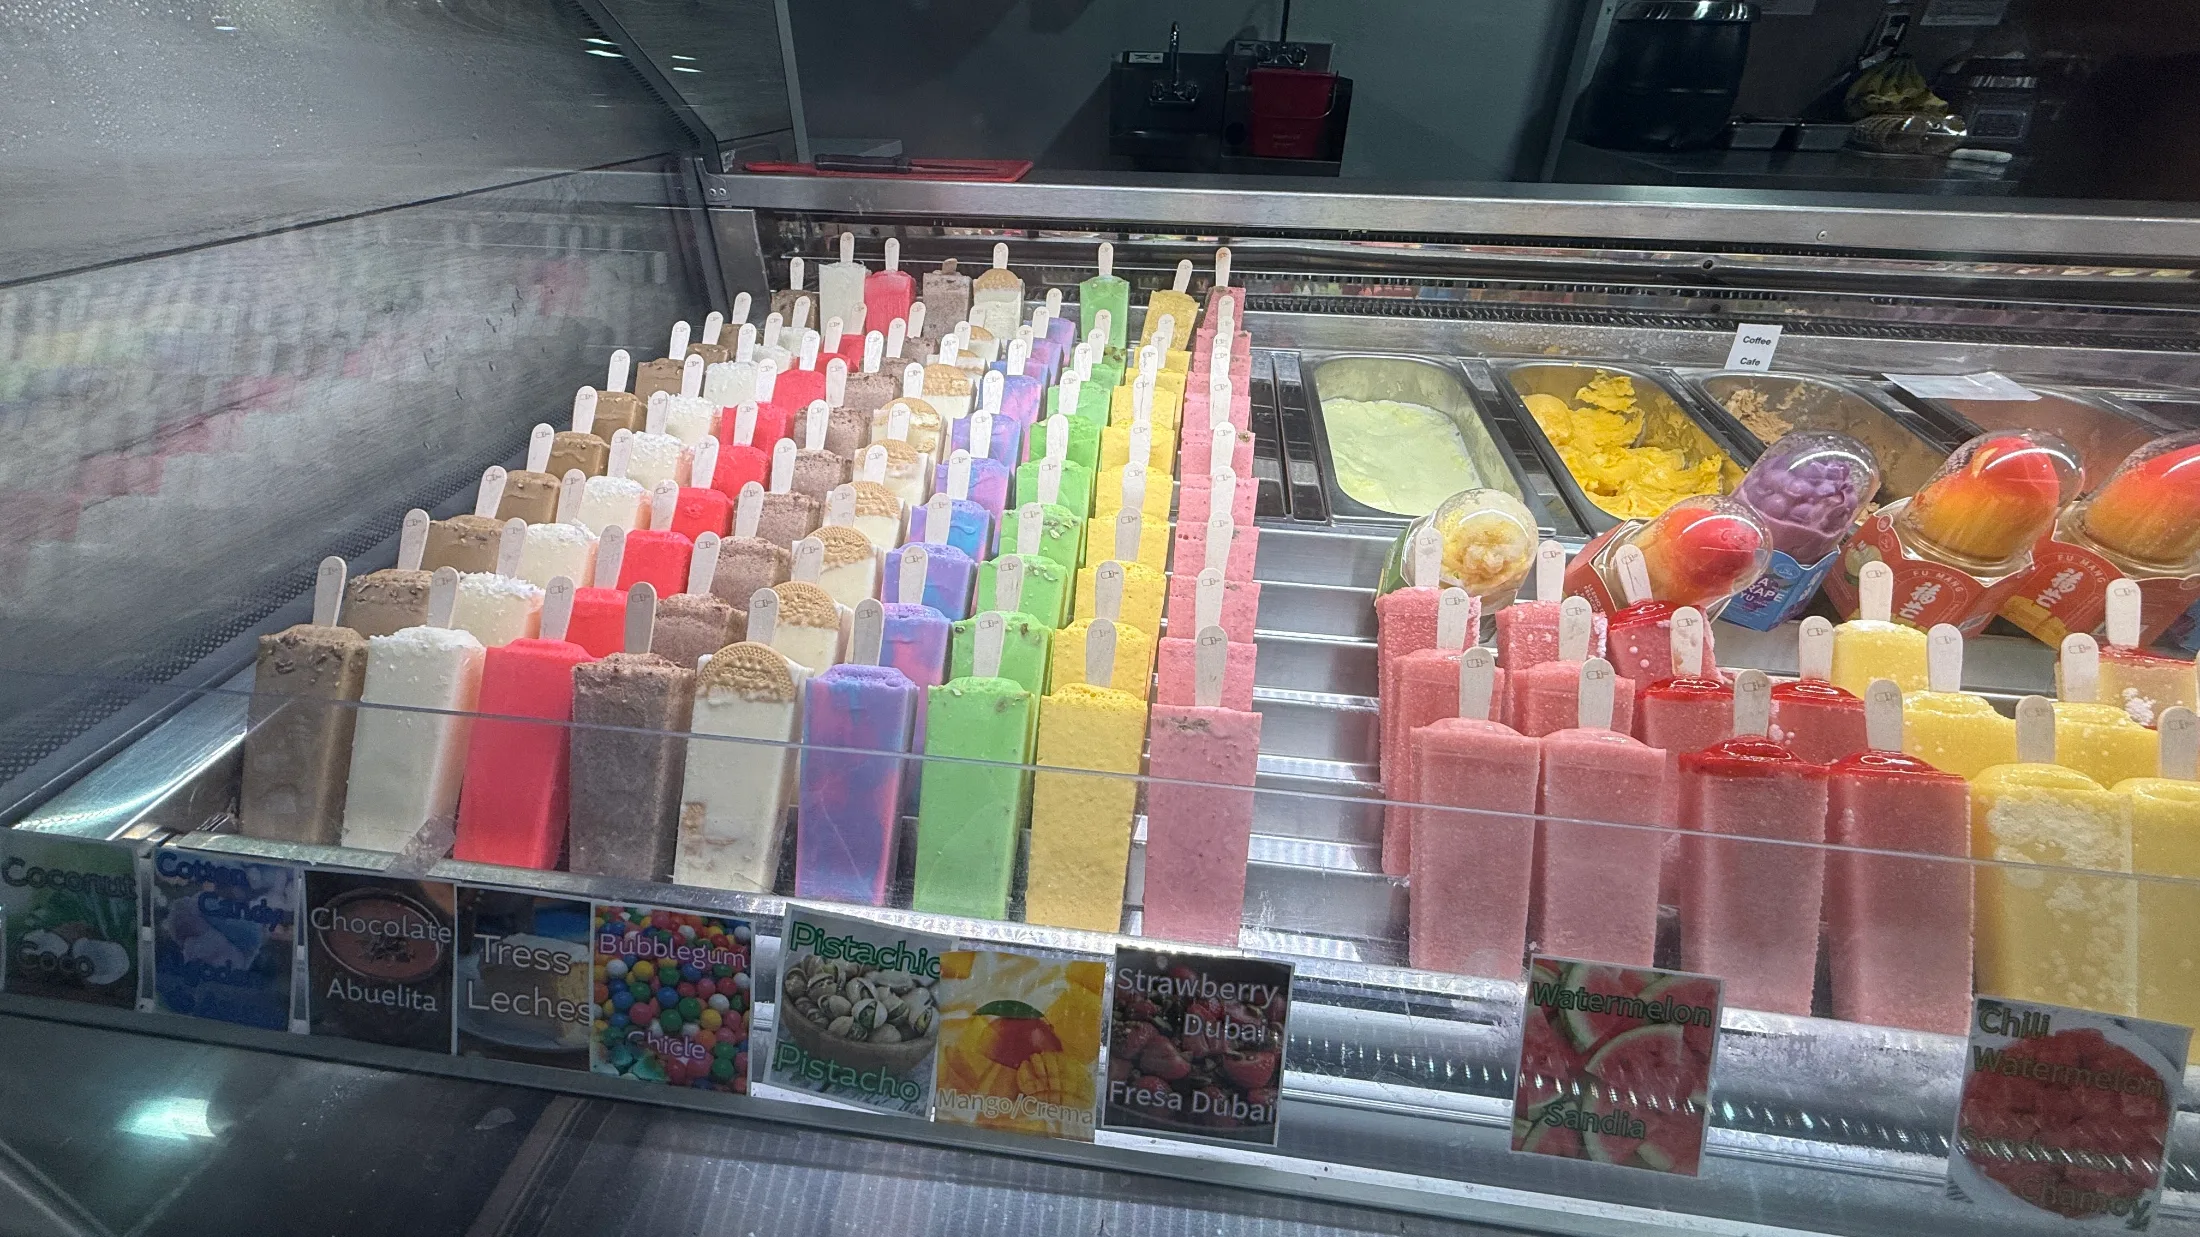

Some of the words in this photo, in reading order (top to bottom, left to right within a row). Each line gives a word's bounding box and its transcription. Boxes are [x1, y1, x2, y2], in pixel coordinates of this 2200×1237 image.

[1743, 335, 1772, 346] Coffee
[1936, 572, 1964, 594] MANG
[2057, 554, 2074, 562] FU
[2079, 558, 2106, 584] MANG
[1748, 583, 1785, 603] RAPE
[2, 855, 137, 900] Coconut
[157, 851, 248, 886] Cotton
[198, 891, 284, 931] Candy
[310, 905, 452, 944] Chocolate
[17, 940, 95, 977] Coco
[474, 933, 572, 975] Tress
[598, 932, 749, 970] Bubblegum
[326, 978, 438, 1013] Abuelita
[467, 979, 591, 1026] Leches
[1117, 965, 1279, 1007] Strawberry
[1532, 980, 1712, 1027] Watermelon
[1183, 1011, 1267, 1042] Dubai
[1978, 1005, 2051, 1038] Chili
[627, 1029, 706, 1060] Chicle
[776, 1042, 921, 1102] Pistacho
[1973, 1045, 2164, 1099] Watermelon
[938, 1088, 1094, 1126] Mango/Crema
[1110, 1081, 1182, 1110] Fresa
[1190, 1089, 1276, 1124] Dubai
[1545, 1101, 1648, 1139] Sandia
